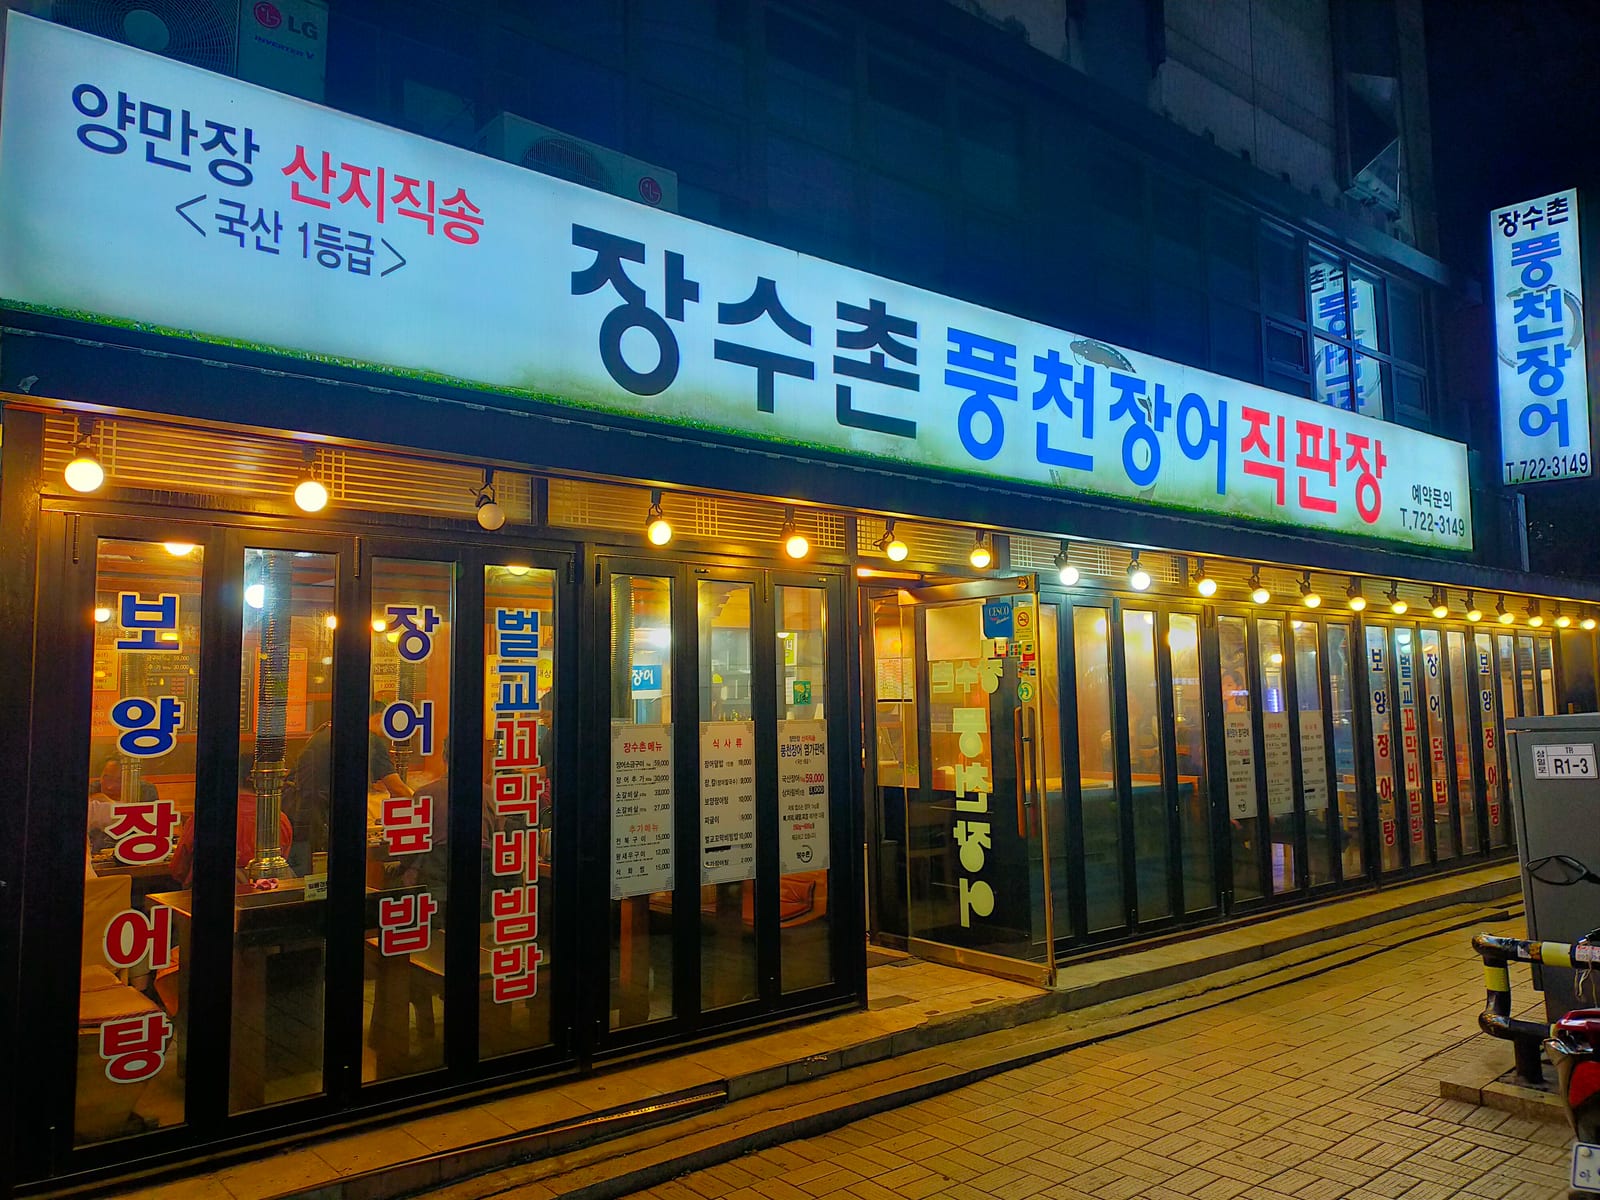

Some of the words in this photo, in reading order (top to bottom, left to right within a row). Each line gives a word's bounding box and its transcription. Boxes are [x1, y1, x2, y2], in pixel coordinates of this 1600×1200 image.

[288, 15, 318, 41] LG
[71, 83, 260, 187] 양만장
[280, 145, 486, 244] 산지직송
[1498, 196, 1569, 237] 장수촌
[1510, 231, 1572, 448] 풍천장어
[571, 223, 920, 439] 장수촌
[944, 326, 1227, 496] 풍천장어
[1240, 405, 1387, 524] 직판장
[1505, 451, 1589, 484] T.722-3149
[1411, 484, 1453, 511] 예약문의
[1400, 507, 1465, 537] T.722-3149
[1554, 758, 1589, 774] R1-3
